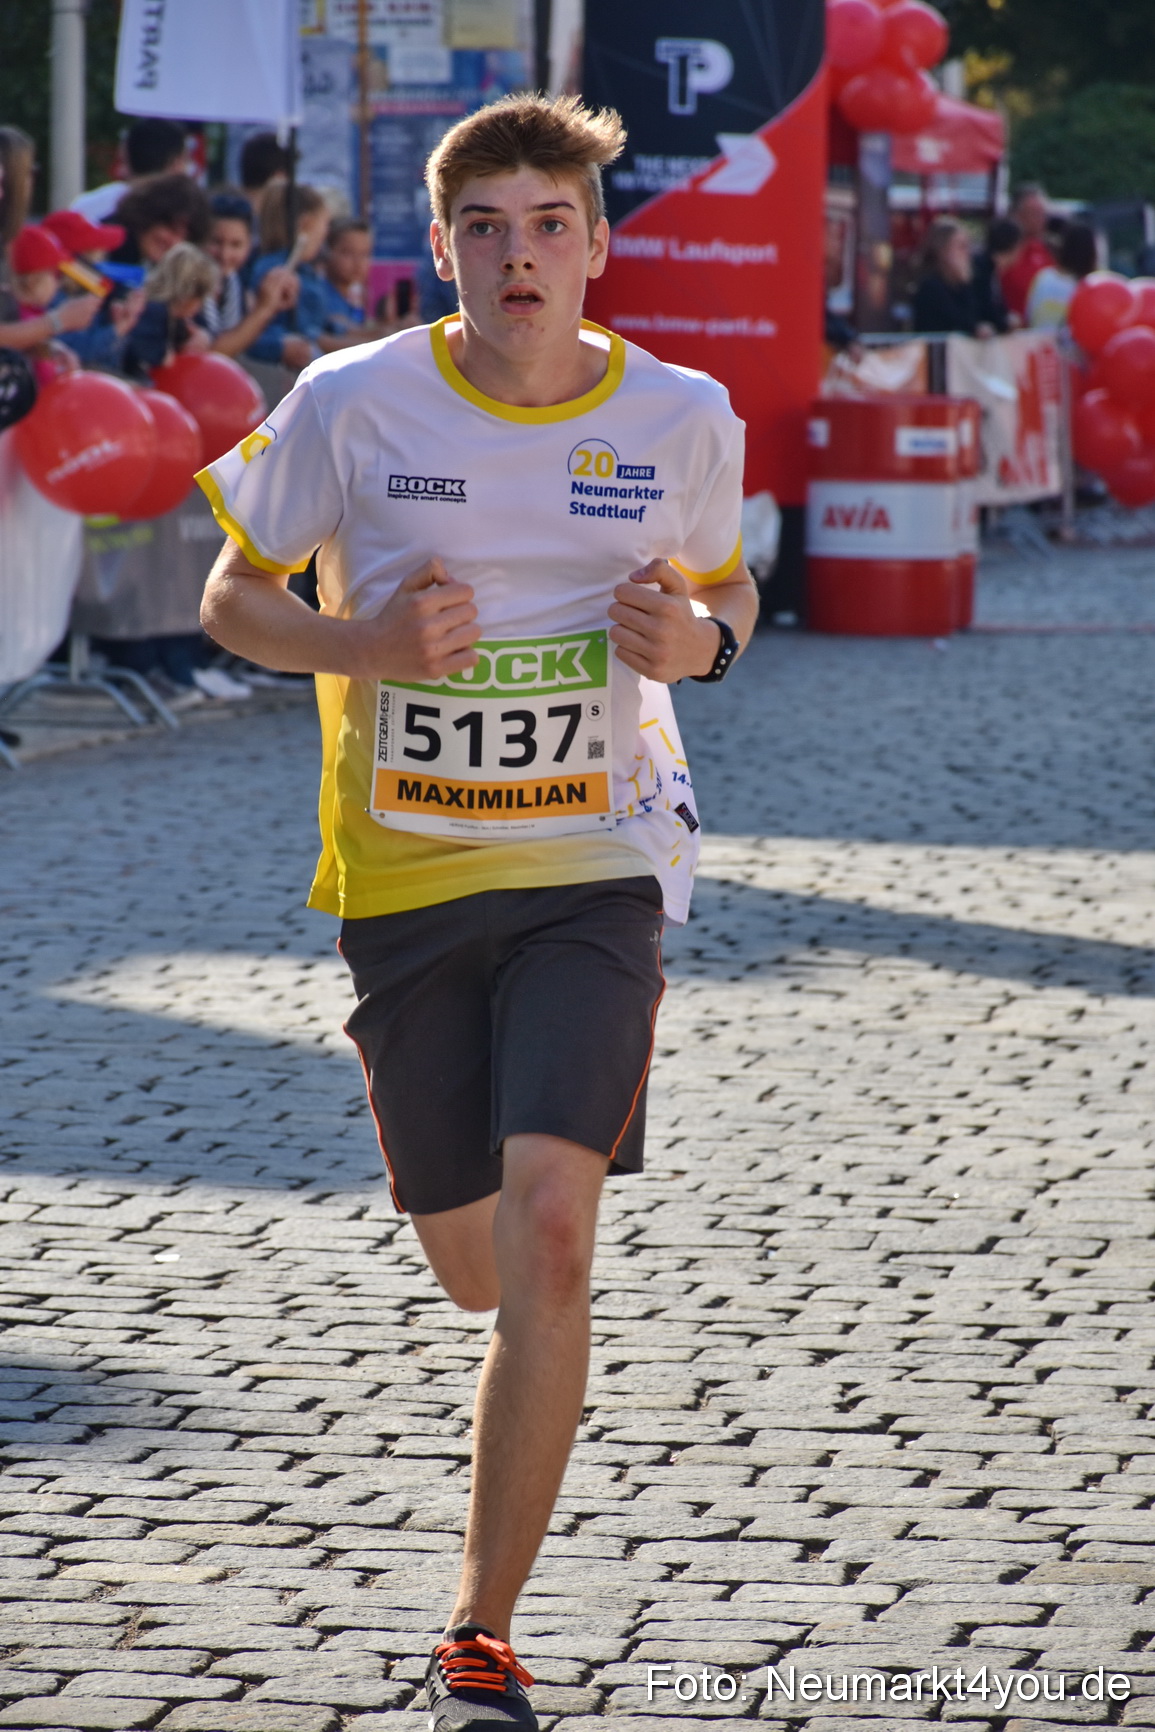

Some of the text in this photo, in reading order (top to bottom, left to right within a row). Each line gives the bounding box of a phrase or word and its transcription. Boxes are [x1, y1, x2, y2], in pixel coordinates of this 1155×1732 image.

[668, 235, 778, 266] Laufsport
[573, 449, 652, 478] 20 JAHRE
[388, 475, 466, 497] BOCK
[571, 481, 665, 500] Neumarkter
[569, 501, 646, 523] Stadtlauf
[420, 639, 592, 691] OCK
[403, 703, 582, 768] 5137
[397, 779, 587, 810] MAXIMILIAN
